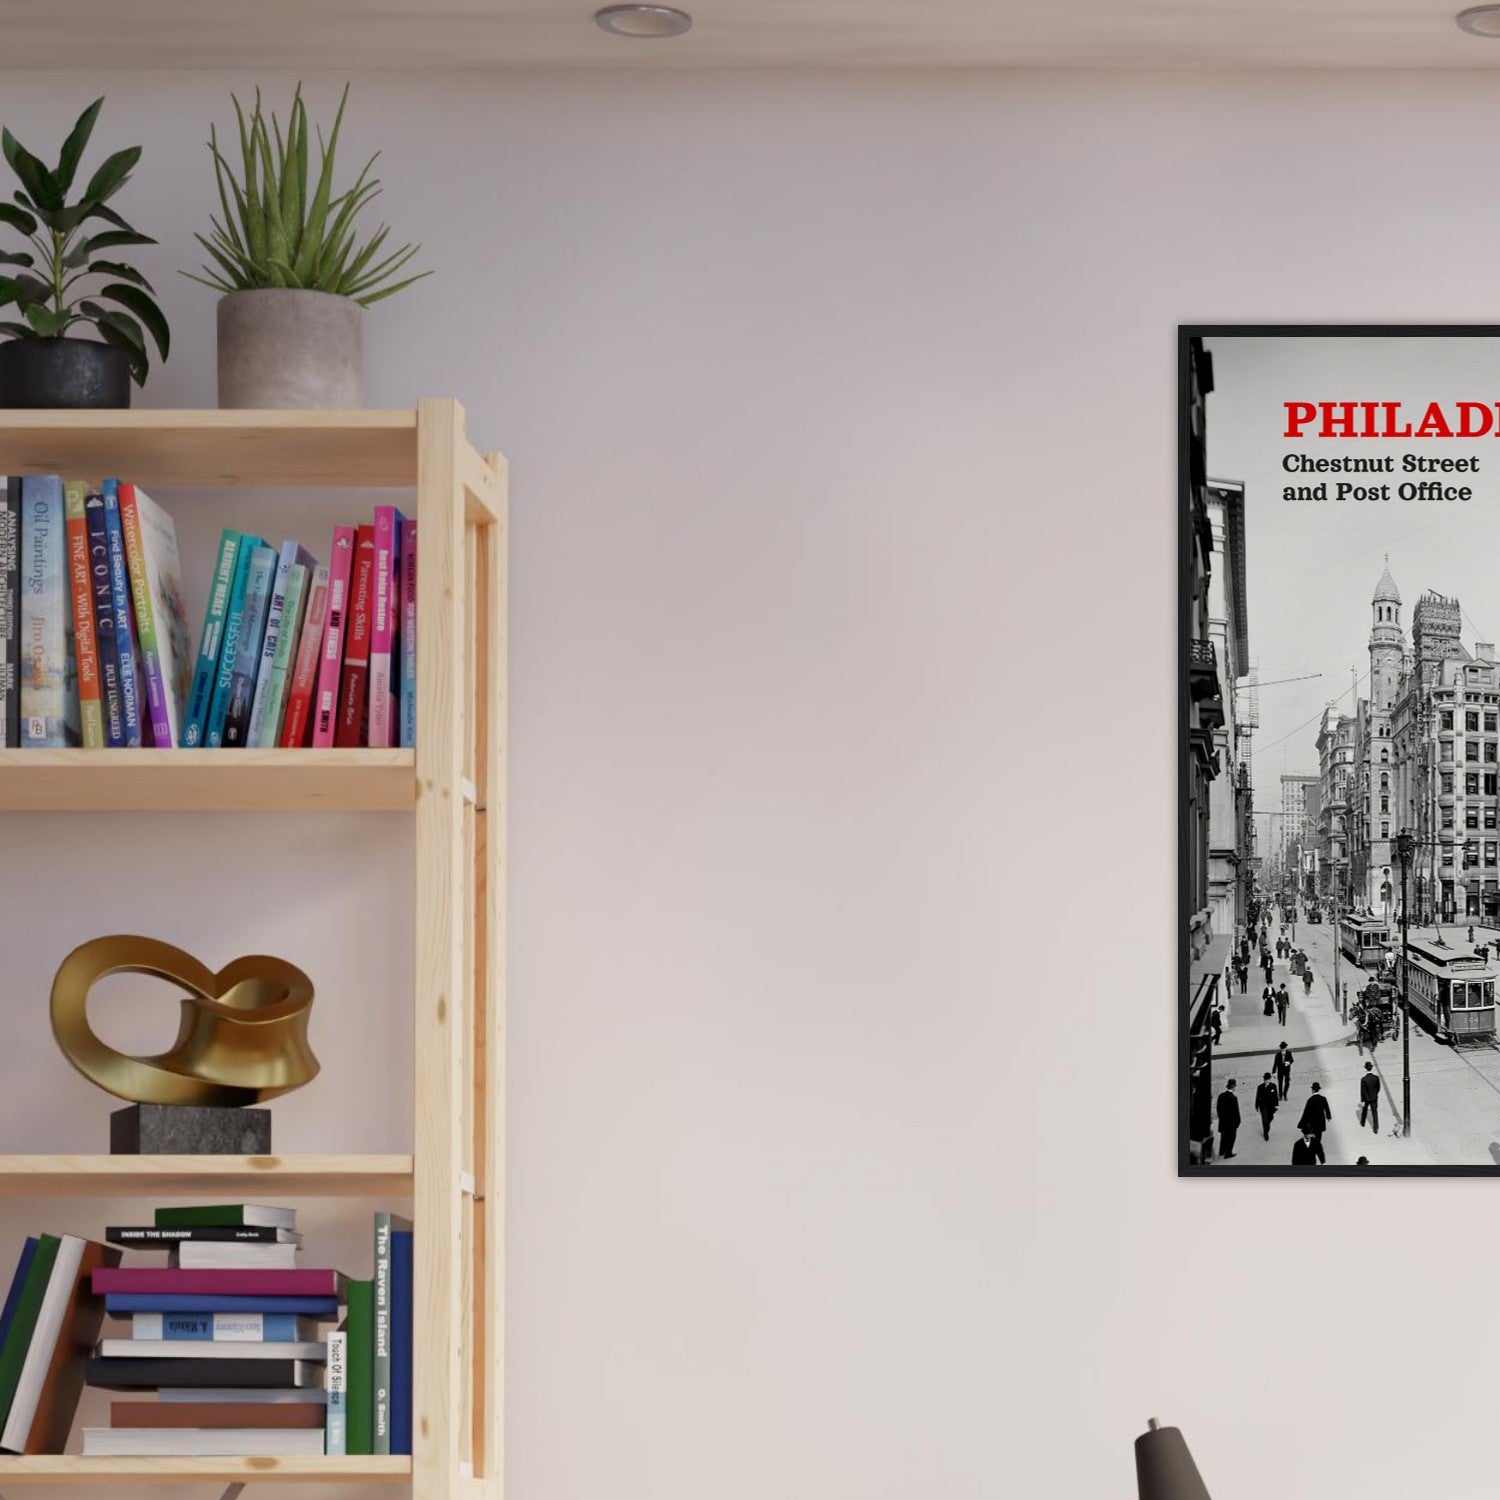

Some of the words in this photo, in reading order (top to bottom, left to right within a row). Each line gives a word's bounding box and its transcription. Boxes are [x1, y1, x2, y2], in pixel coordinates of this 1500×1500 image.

[1282, 453, 1394, 473] Chestnut
[1402, 453, 1480, 473] Street
[1282, 481, 1328, 502] and
[1336, 481, 1391, 502] Post
[1398, 481, 1473, 502] Office
[34, 502, 50, 524] Oil
[7, 510, 16, 571] ANALYSING
[73, 535, 85, 561] FINE
[111, 530, 120, 552] Find
[28, 528, 49, 594] Paintings
[75, 562, 87, 585] ART
[113, 554, 124, 592] Beauty
[124, 505, 142, 576] Watercolor
[135, 578, 149, 633] Portraits
[91, 531, 113, 629] ICONIC
[354, 561, 371, 612] Parenting
[78, 593, 90, 618] With
[211, 583, 228, 616] MEALS
[273, 592, 285, 612] ART
[117, 607, 127, 629] ART
[354, 612, 367, 641] Skills
[76, 620, 93, 654] Digital
[220, 612, 243, 688] SUCCESSFUL
[264, 635, 278, 658] CATS
[6, 663, 14, 690] MARK
[81, 655, 96, 682] Tools
[121, 652, 132, 679] ELLE
[123, 678, 137, 727] NORMAN
[378, 1226, 388, 1255] The
[378, 1259, 388, 1306] Raven
[377, 1310, 388, 1357] Island
[332, 1339, 342, 1362] Touch
[332, 1364, 342, 1374] Of
[332, 1375, 342, 1406] Silence
[377, 1404, 386, 1436] Smith
